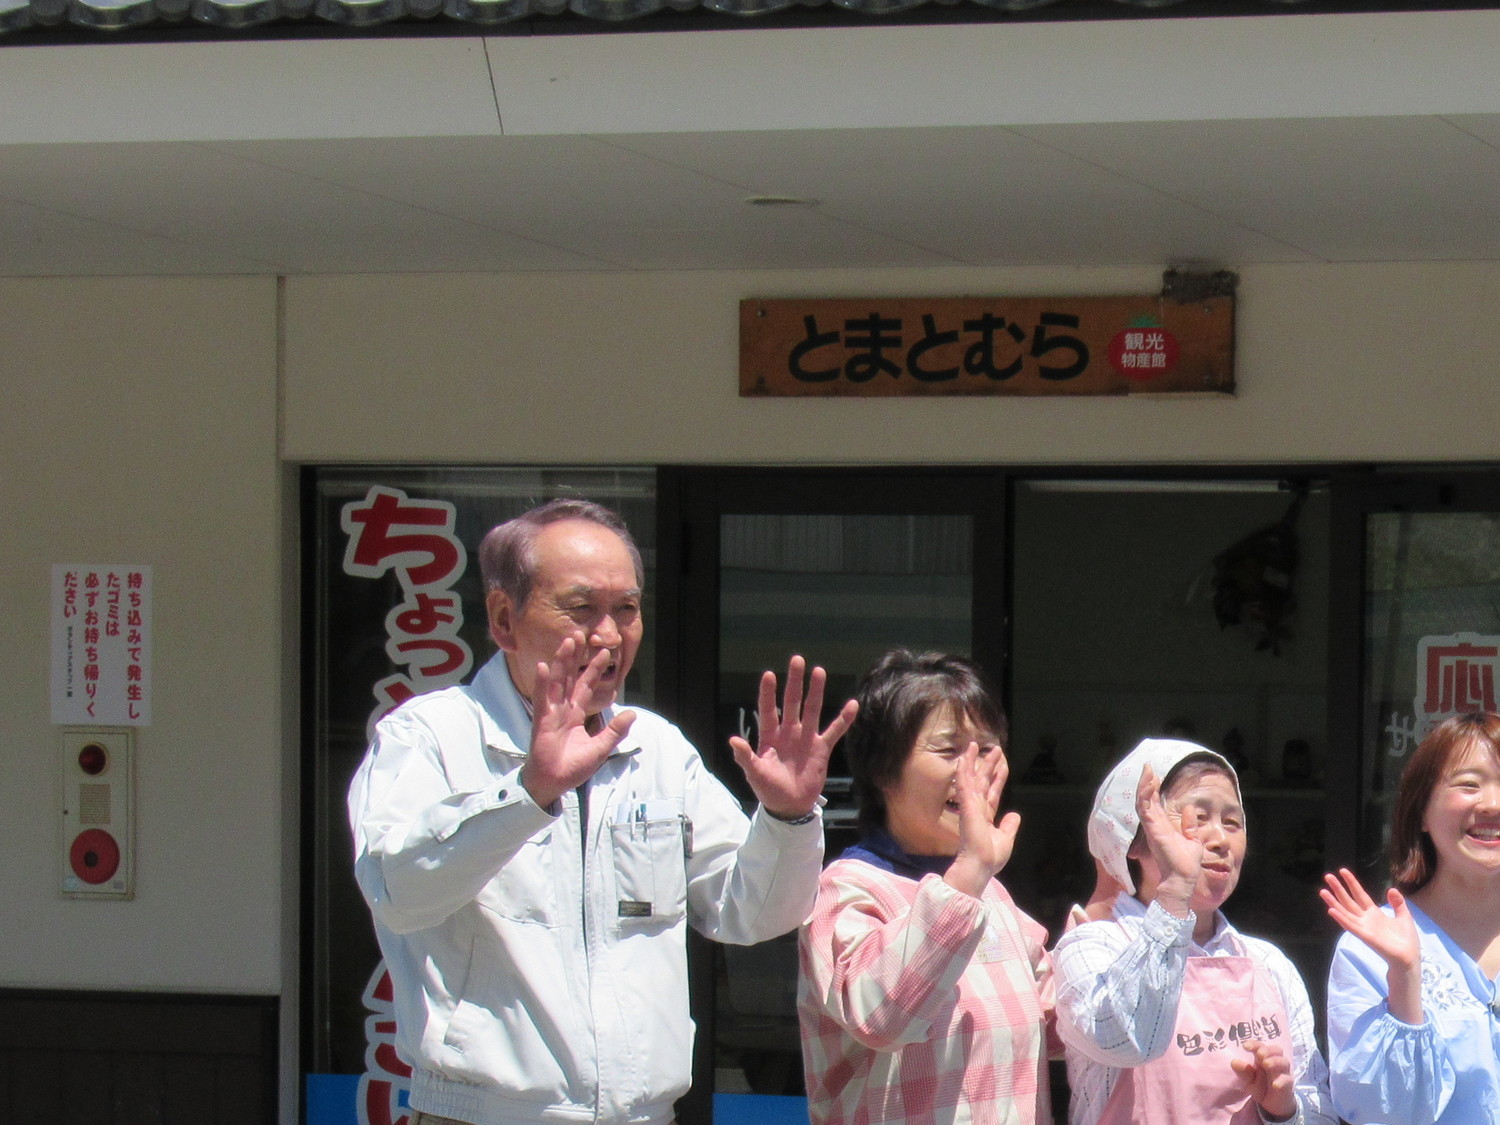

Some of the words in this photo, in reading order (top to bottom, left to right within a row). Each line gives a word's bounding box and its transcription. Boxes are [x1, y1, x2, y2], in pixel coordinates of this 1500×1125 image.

[788, 312, 1090, 383] とまとむら
[1121, 352, 1167, 369] 物産館
[1125, 331, 1165, 351] 観光
[63, 571, 78, 619] ださい
[106, 571, 120, 637] たゴミは
[84, 571, 100, 718] 必ずお持ち帰りく
[127, 571, 143, 720] 持ち込みで発生し
